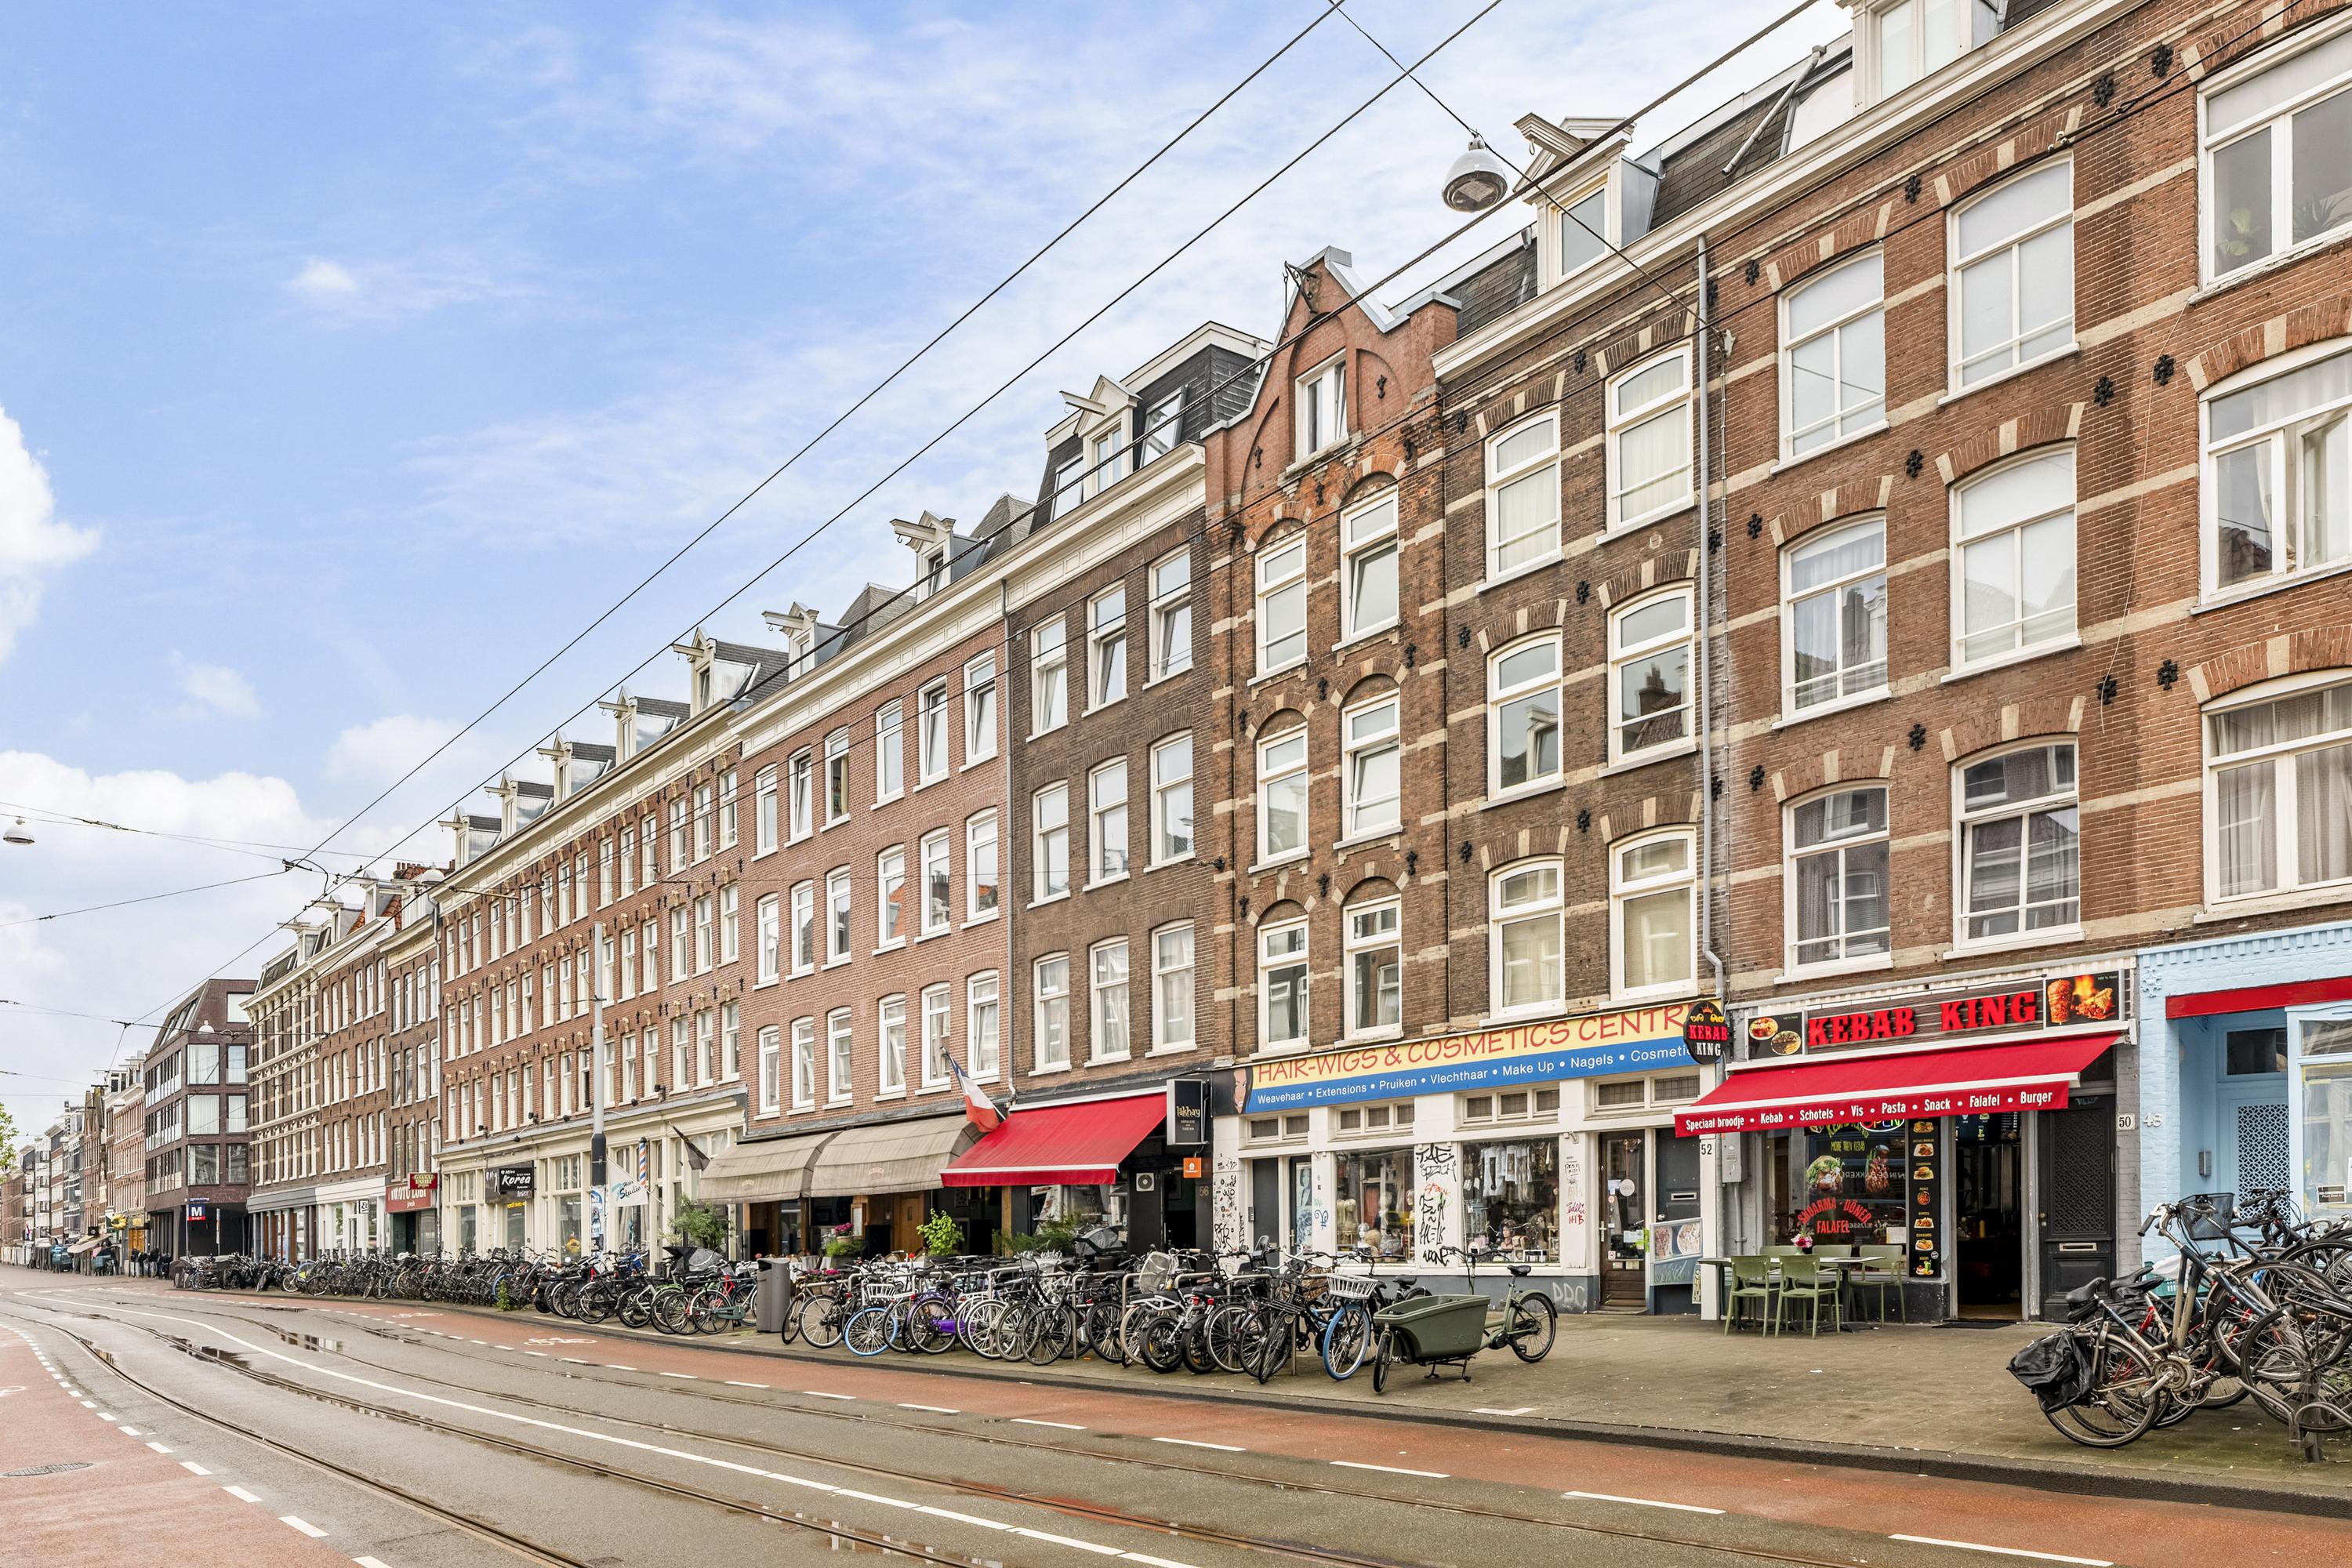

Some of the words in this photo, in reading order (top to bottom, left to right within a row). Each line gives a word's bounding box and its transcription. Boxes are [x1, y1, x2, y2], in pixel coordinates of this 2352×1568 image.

[1808, 1007, 1916, 1047] KEBAB
[1939, 991, 2037, 1032] KING
[1688, 1024, 1729, 1041] KEBAB
[1258, 1049, 1378, 1083] HAIR-WIGS
[1385, 1050, 1402, 1067] &
[1407, 1020, 1570, 1063] COSMETICS
[1578, 1004, 1693, 1041] CENTR
[1696, 1042, 1722, 1057] KING
[1257, 1091, 1305, 1105] Weavehaar
[1316, 1083, 1367, 1098] Extensions
[1379, 1077, 1417, 1091] Pruiken
[1430, 1069, 1488, 1084] Vlechthaar
[1502, 1063, 1534, 1077] Make
[1537, 1061, 1555, 1075] Up
[1570, 1054, 1614, 1069] Nagels
[1686, 1117, 1715, 1132] Speciaal
[1717, 1115, 1744, 1130] broodje
[1760, 1112, 1784, 1124] Kebab
[1799, 1108, 1834, 1121] Schotels
[1851, 1105, 1864, 1117] Vis
[1882, 1102, 1906, 1114] Pasta
[1924, 1098, 1951, 1112] Snack
[1969, 1094, 2000, 1108] Falafel
[2020, 1091, 2053, 1107] Burger
[2118, 1116, 2132, 1127] 50
[2143, 1112, 2163, 1127] 48
[1700, 1143, 1713, 1156] 52
[501, 1174, 532, 1186] Korea
[619, 1185, 641, 1200] Studio
[1199, 1185, 1210, 1196] 56
[191, 1207, 202, 1217] M
[1797, 1197, 1837, 1225] SHOARMA
[1816, 1220, 1850, 1234] FALAFEL
